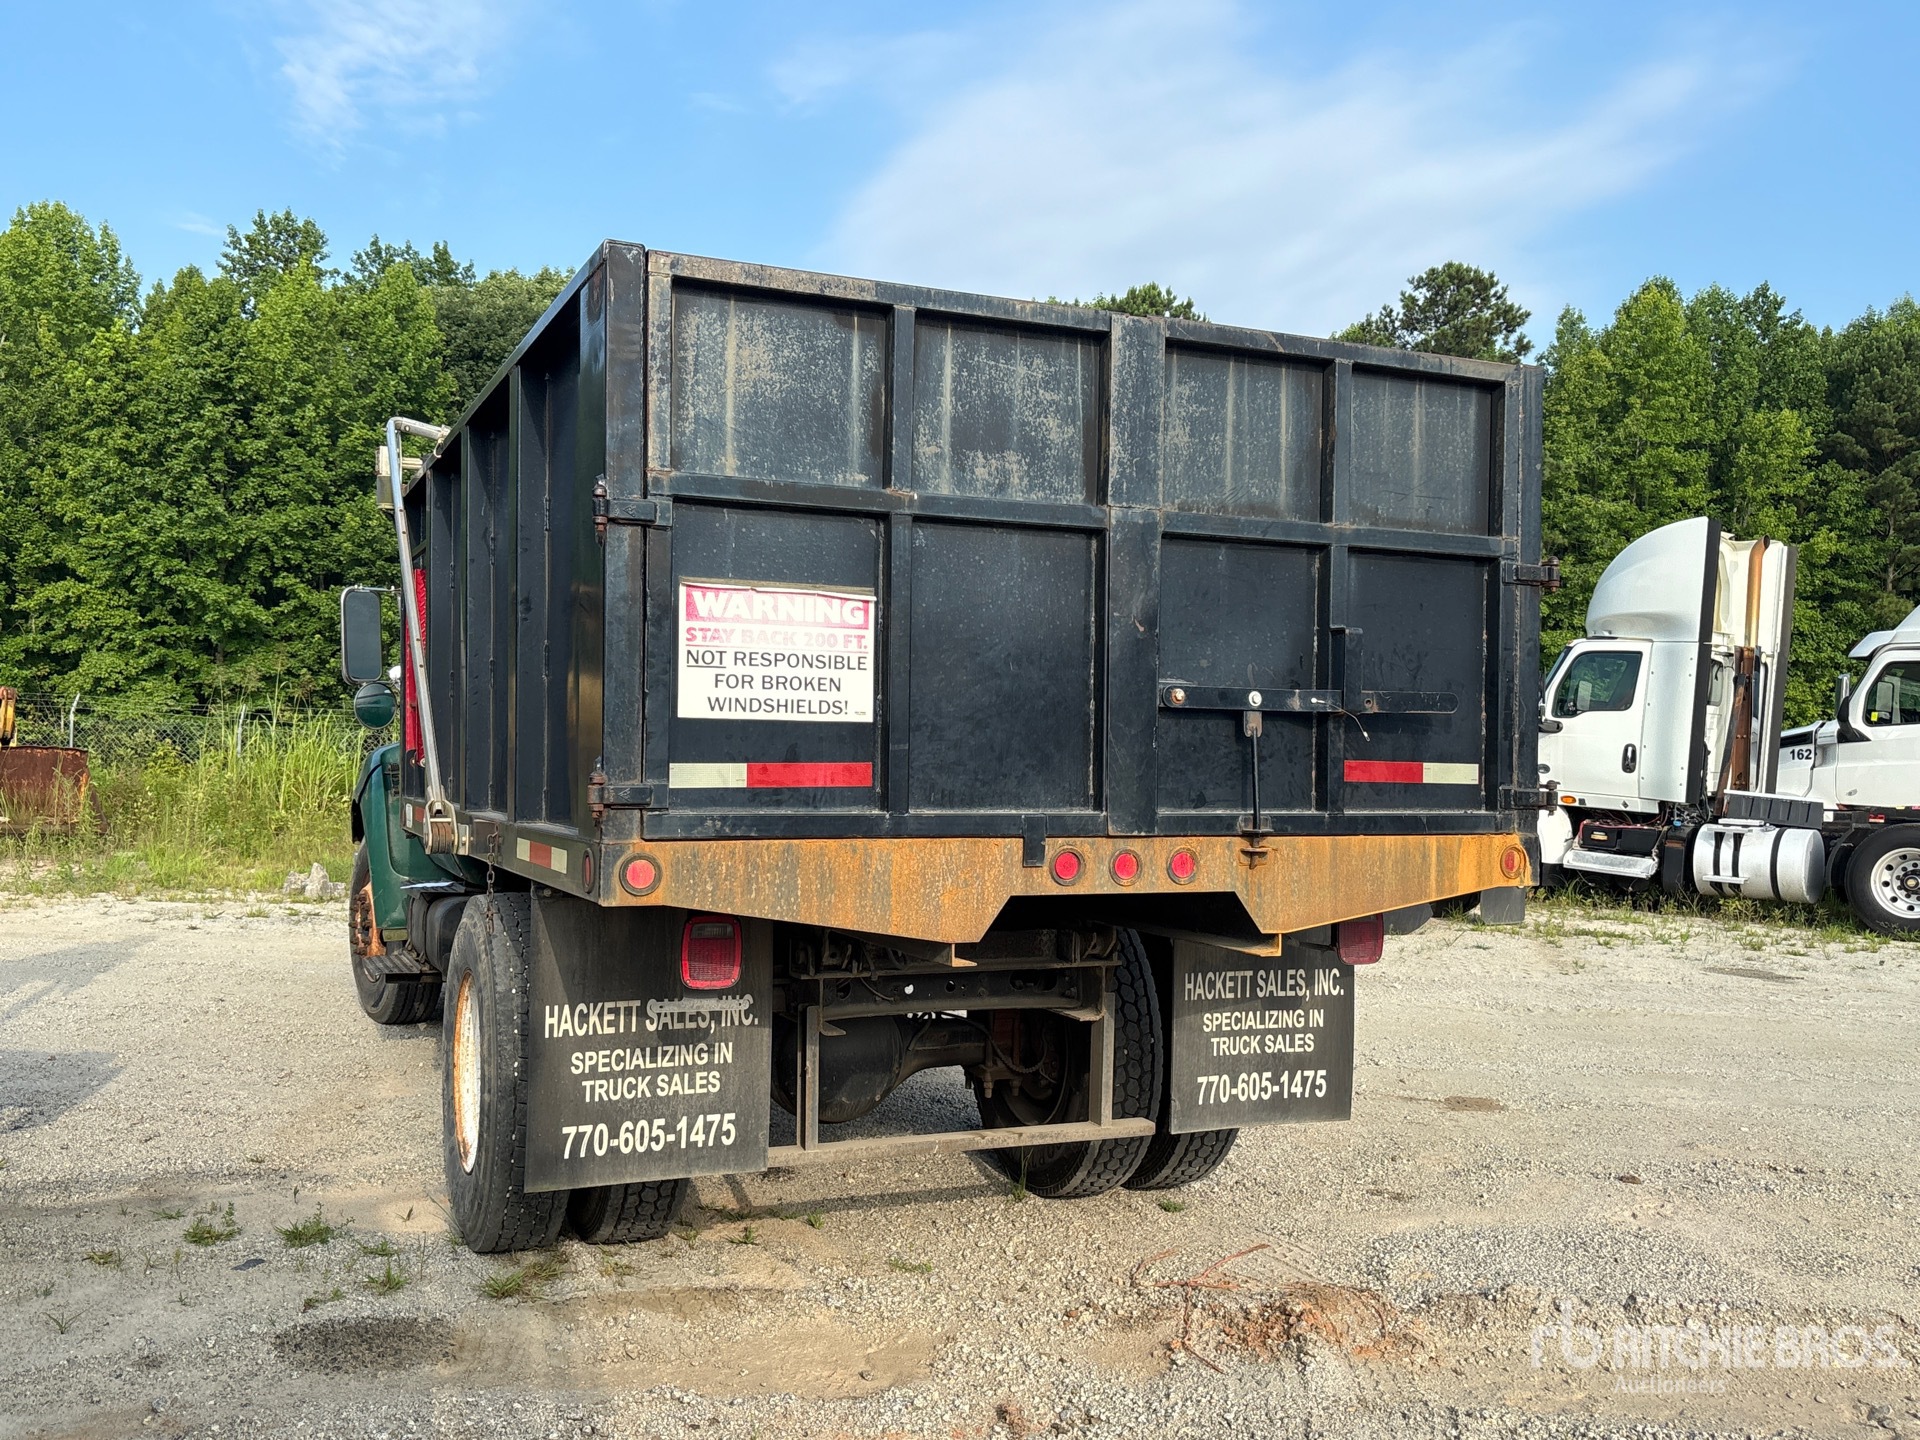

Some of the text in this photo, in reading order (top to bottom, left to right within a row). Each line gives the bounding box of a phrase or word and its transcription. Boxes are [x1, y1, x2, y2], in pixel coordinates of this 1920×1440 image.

[692, 591, 865, 625] WARNING
[685, 626, 868, 650] STAY BACK 200 FT.
[686, 650, 867, 671] NOT RESPONSIBLE
[714, 674, 841, 692] FOR BROKEN
[707, 697, 849, 715] WINDSHIELDS!
[1789, 748, 1812, 760] 162
[1184, 968, 1345, 1001] HACKETT SALES, INC.
[544, 993, 759, 1038] HACKETT SALES, INC.
[1202, 1008, 1324, 1032] SPECIALIZING IN
[570, 1042, 733, 1075] SPECIALIZING IN
[1210, 1033, 1315, 1057] TRUCK SALES
[581, 1070, 721, 1103] TRUCK SALES
[1197, 1069, 1327, 1106] 770-605-1475
[561, 1112, 736, 1160] 770-605-1475
